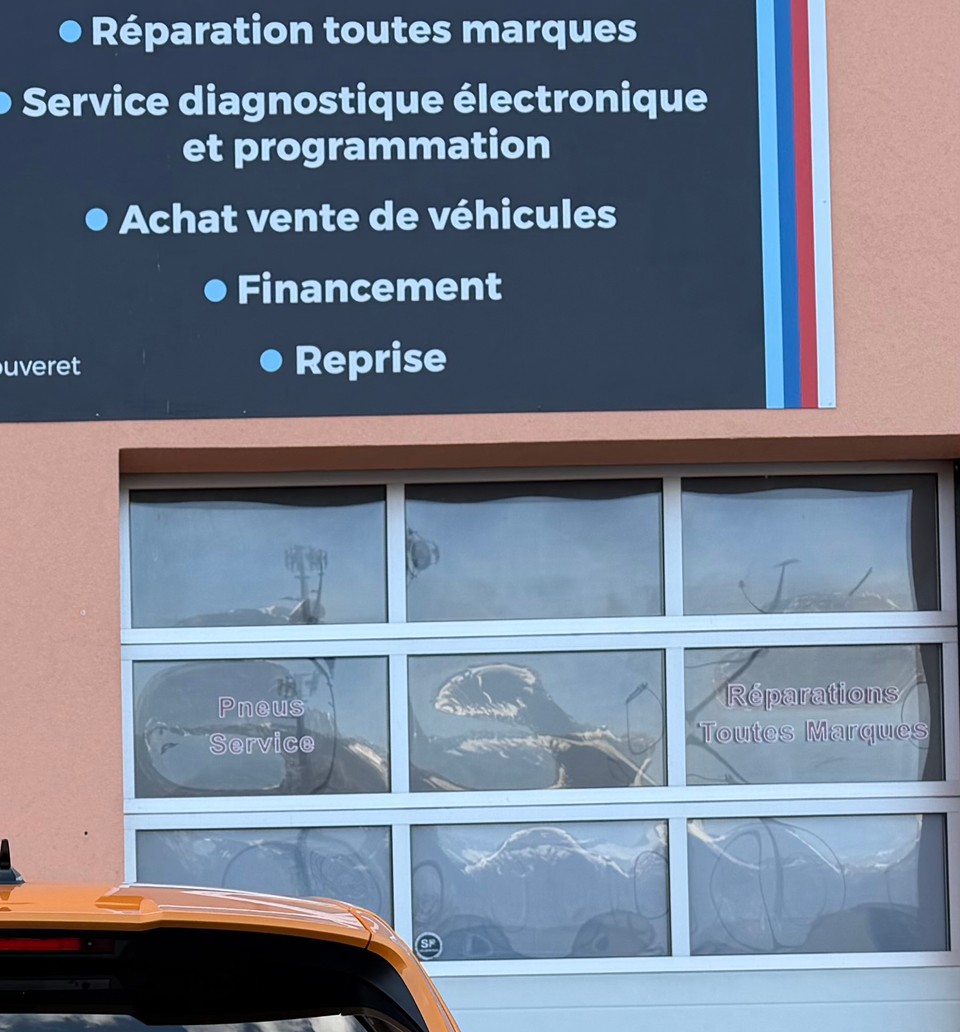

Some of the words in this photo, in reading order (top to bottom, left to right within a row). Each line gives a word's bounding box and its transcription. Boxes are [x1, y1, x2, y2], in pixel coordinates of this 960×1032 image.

[92, 12, 313, 53] Réparation
[322, 16, 452, 45] toutes
[462, 19, 637, 51] marques
[22, 83, 170, 118] Service
[178, 81, 444, 123] diagnostique
[453, 80, 708, 120] électronique
[182, 133, 224, 162] et
[234, 126, 550, 169] programmation
[118, 202, 238, 235] Achat
[246, 203, 360, 233] vente
[368, 200, 419, 231] de
[427, 197, 617, 231] véhicules
[238, 271, 503, 305] Financement
[296, 341, 447, 382] Reprise
[218, 696, 305, 718] Pneus
[726, 682, 901, 710] Réparations
[209, 731, 315, 755] Service
[699, 720, 795, 744] Toutes
[805, 719, 929, 746] Marques
